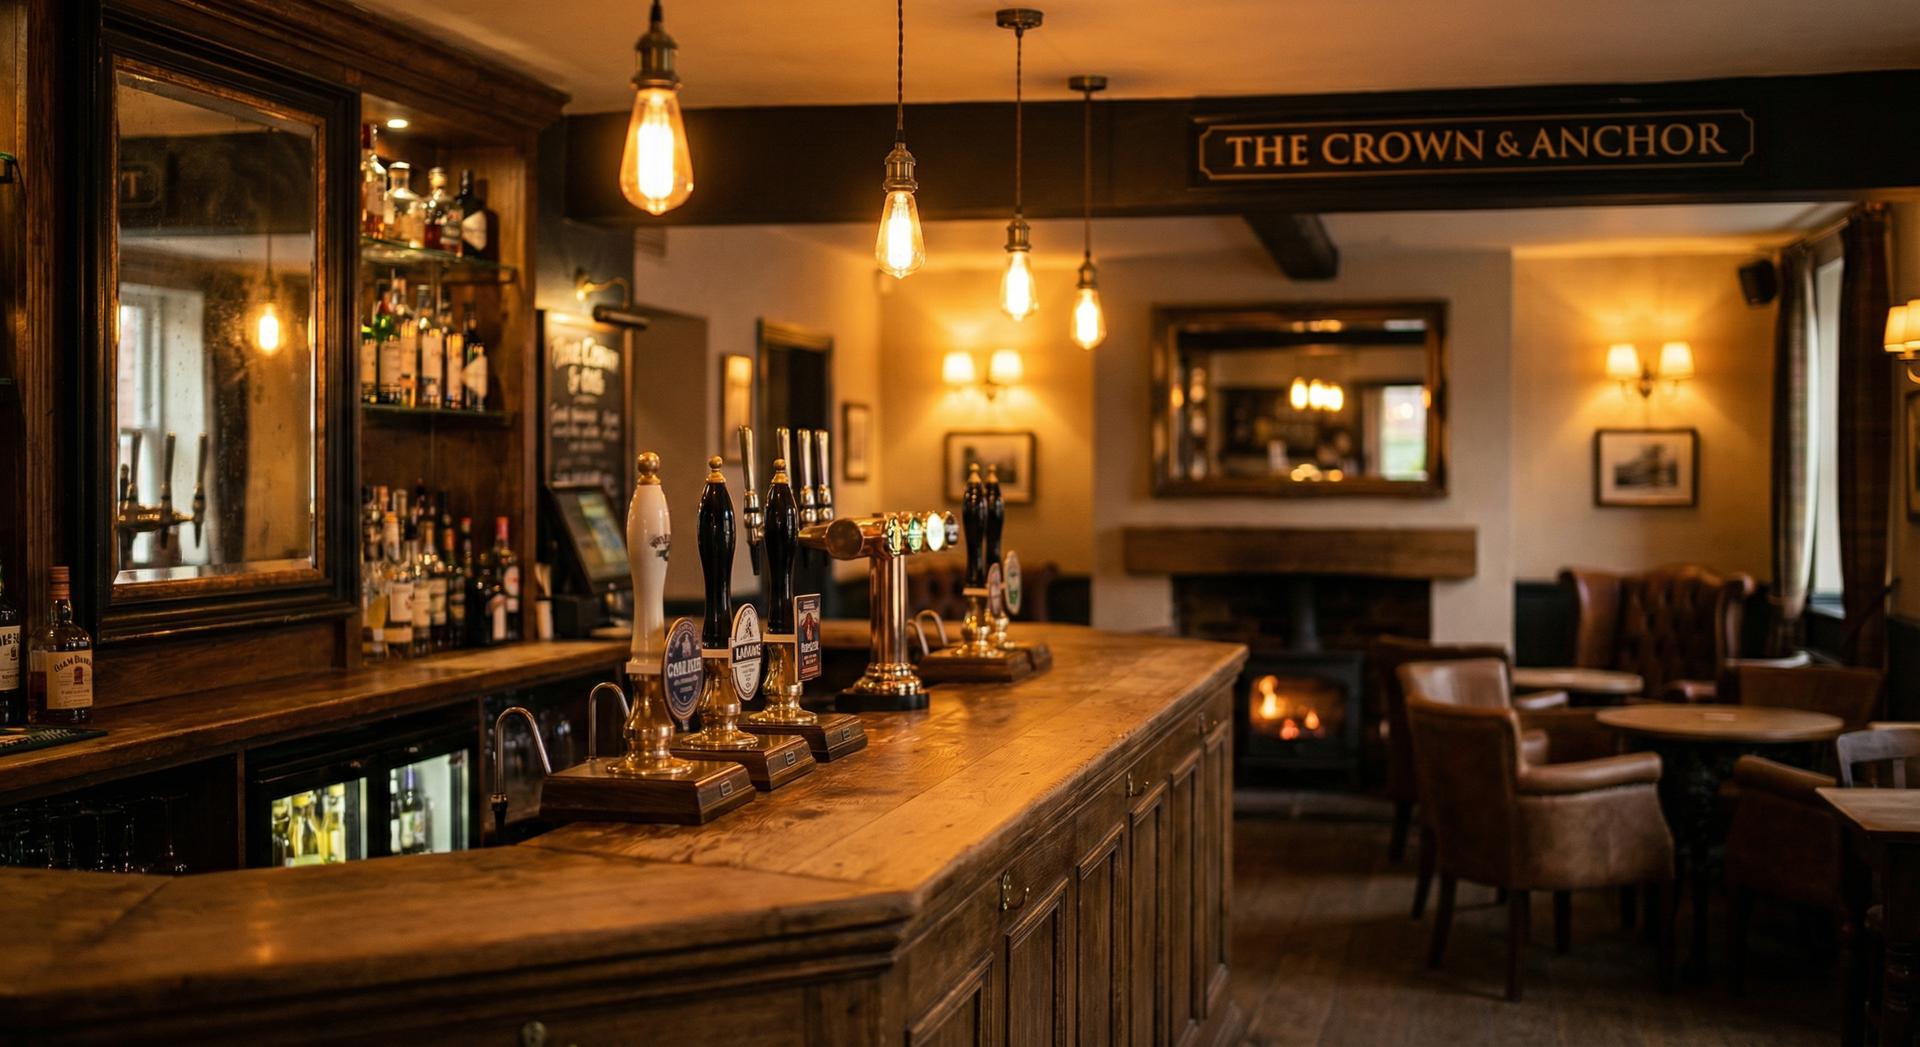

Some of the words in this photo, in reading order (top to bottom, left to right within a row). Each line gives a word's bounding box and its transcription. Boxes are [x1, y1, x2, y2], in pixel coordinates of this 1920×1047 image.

[1226, 135, 1308, 168] THE
[1321, 129, 1485, 165] CROWN
[1495, 131, 1520, 158] &
[1527, 121, 1728, 160] ANCHOR
